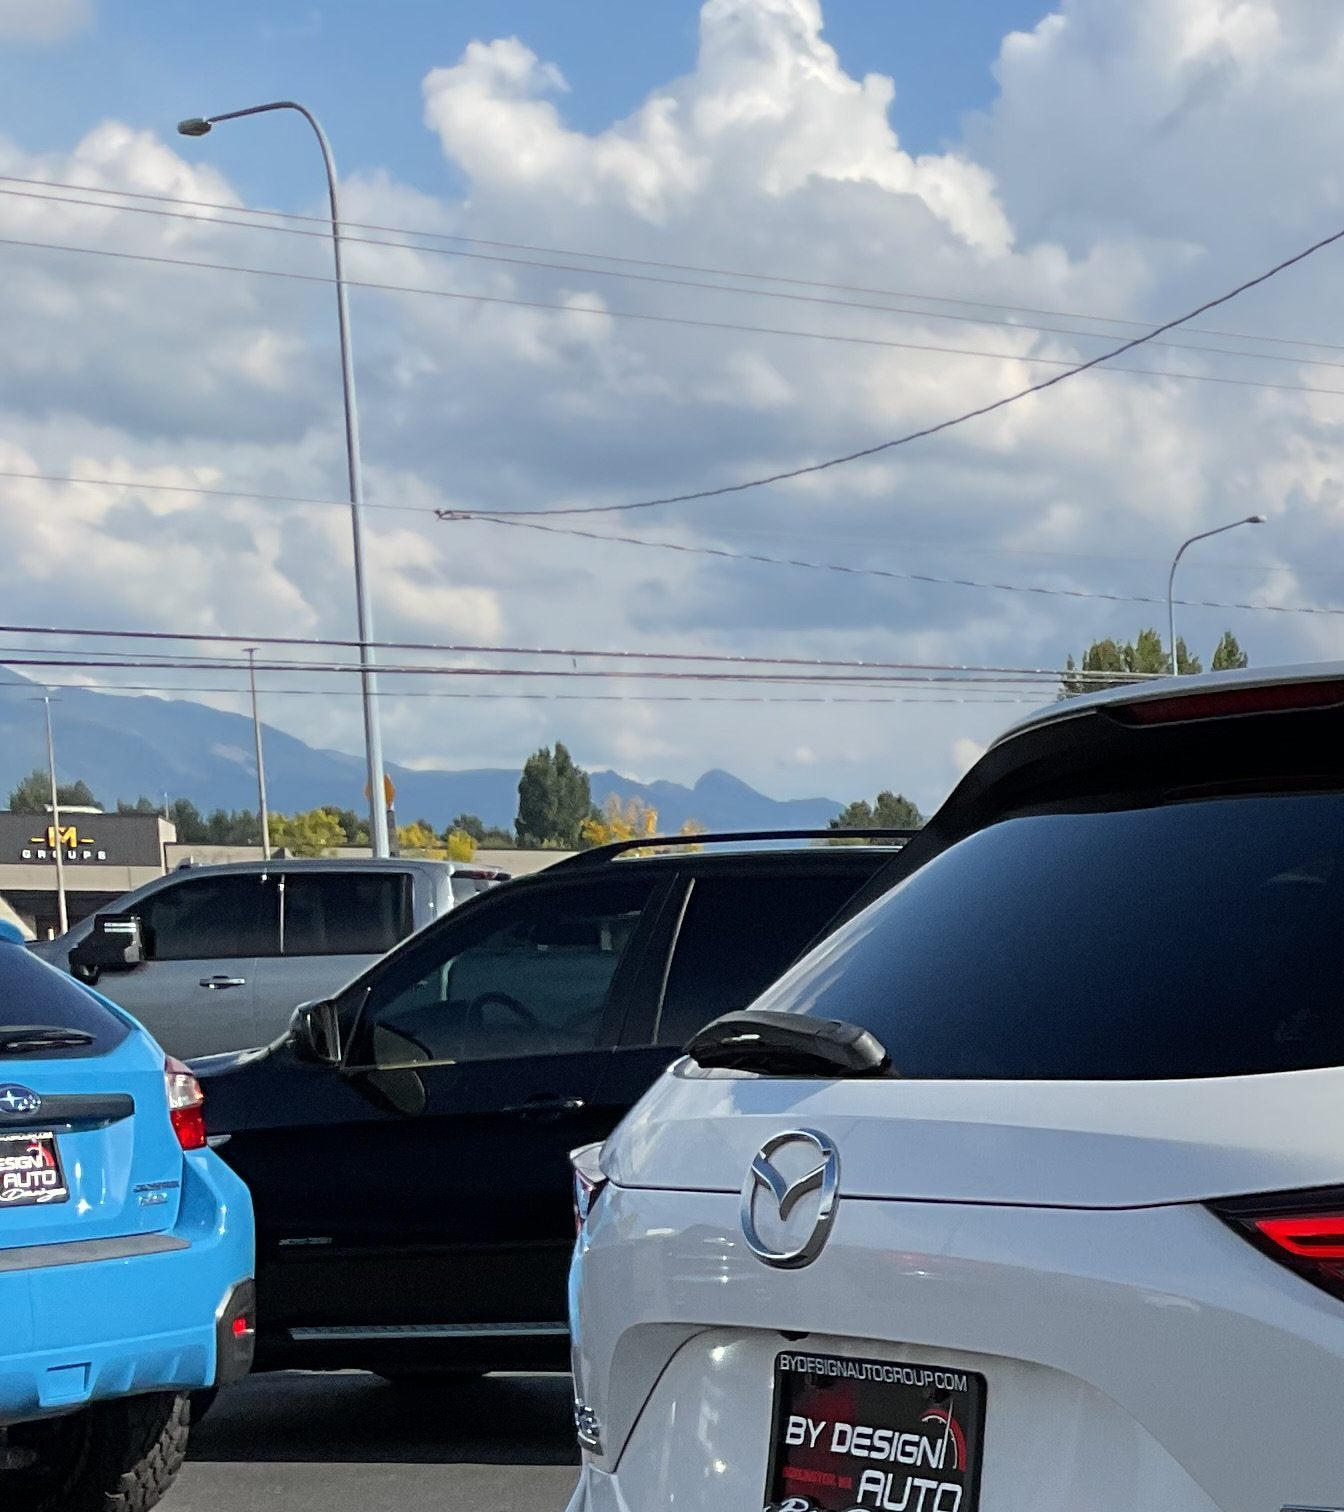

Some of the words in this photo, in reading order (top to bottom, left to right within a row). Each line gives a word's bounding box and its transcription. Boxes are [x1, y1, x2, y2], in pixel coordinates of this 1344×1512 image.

[4, 1169, 57, 1188] AUTO
[785, 1415, 826, 1449] BY
[831, 1422, 944, 1469] DESIGN
